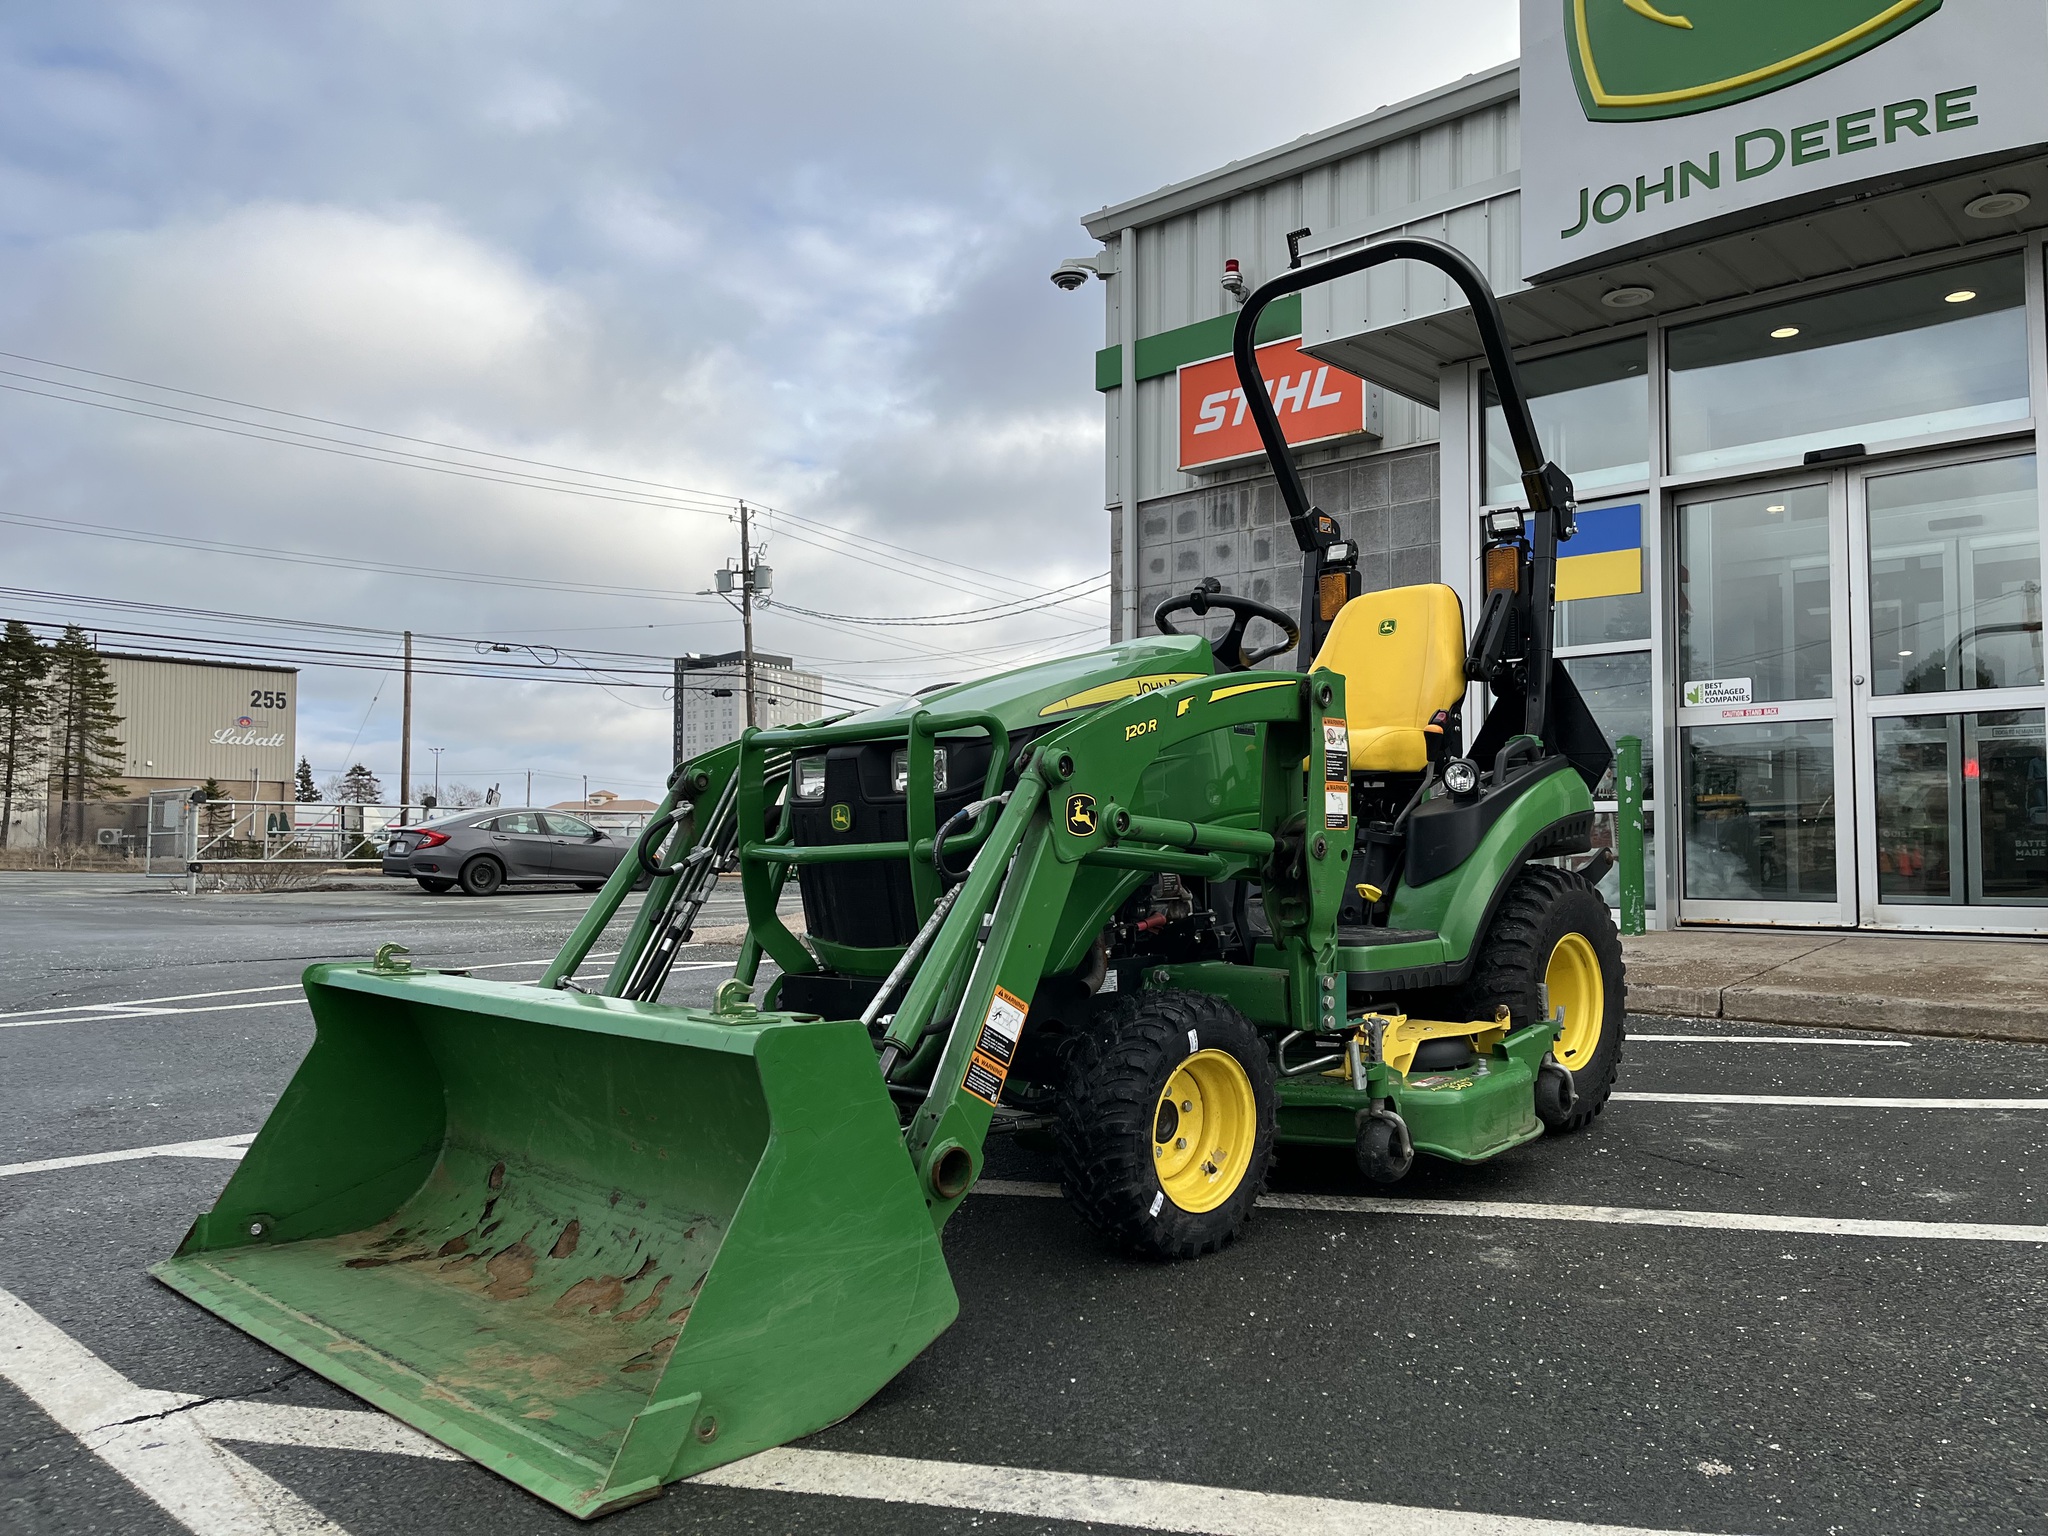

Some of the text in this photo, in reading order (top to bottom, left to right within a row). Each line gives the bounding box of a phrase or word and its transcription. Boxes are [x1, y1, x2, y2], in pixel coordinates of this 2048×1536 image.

[1561, 85, 1980, 240] JOHN DEERE
[1193, 365, 1343, 435] STHL
[1704, 682, 1723, 690] BEST
[1704, 687, 1745, 697] MANAGED
[250, 690, 287, 710] 255
[1704, 694, 1751, 704] COMPANIES
[1327, 719, 1345, 727] WARNING
[209, 727, 286, 747] Labatt
[675, 716, 683, 751] TOWER
[1330, 784, 1347, 792] WARNING
[2015, 848, 2046, 857] MADE
[1003, 993, 1025, 1010] WARNING
[981, 1059, 1004, 1077] WARNING
